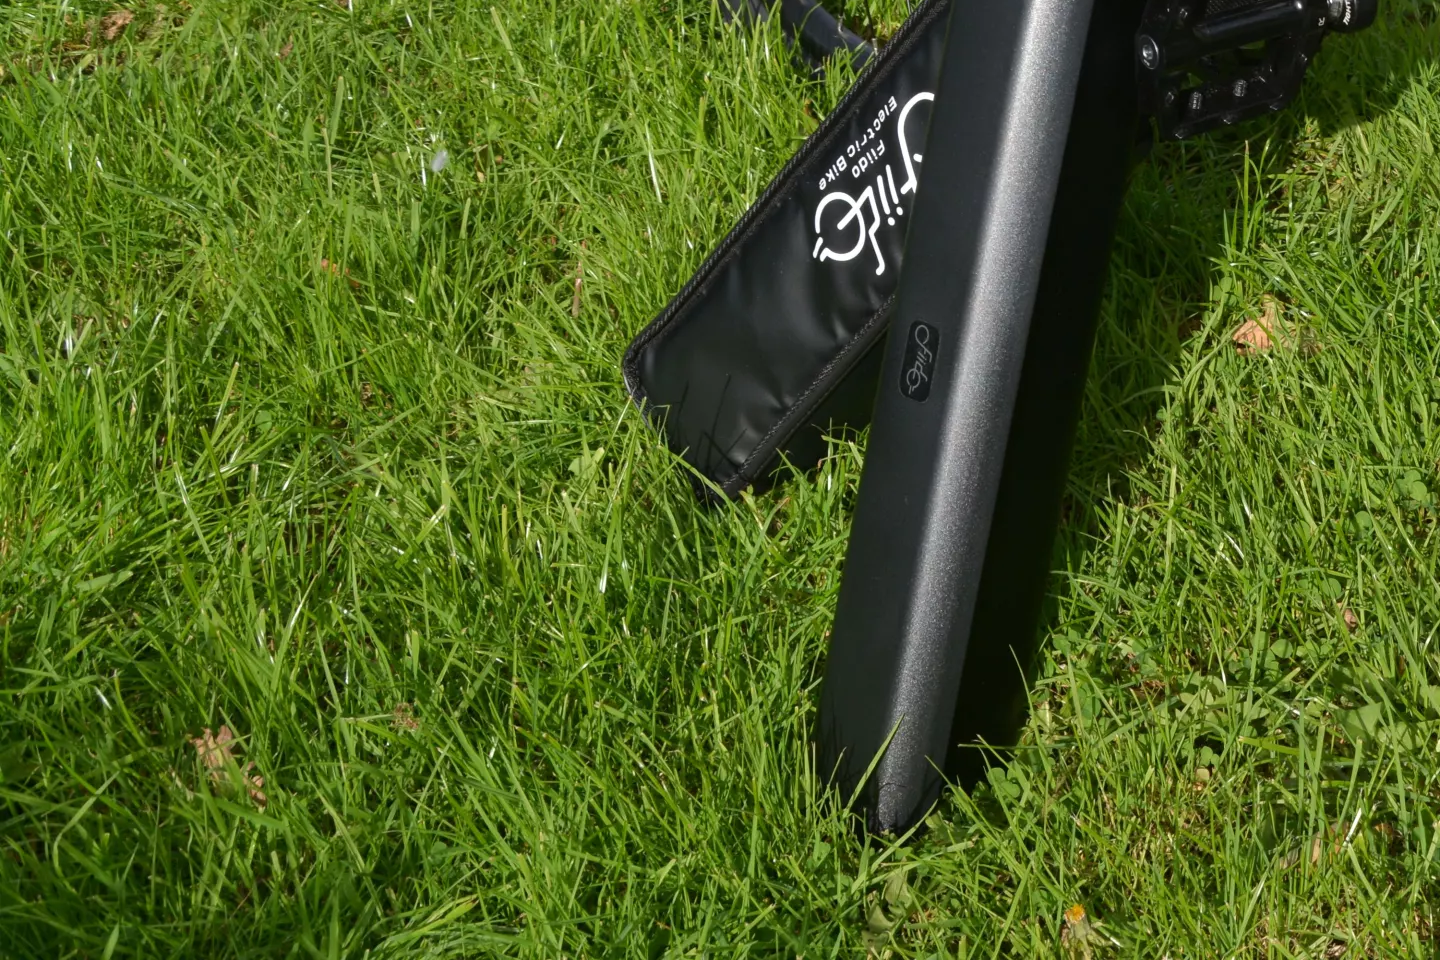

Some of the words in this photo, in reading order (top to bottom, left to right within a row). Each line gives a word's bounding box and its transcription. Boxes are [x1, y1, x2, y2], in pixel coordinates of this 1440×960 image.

[846, 95, 898, 158] Electric
[818, 155, 848, 191] Bike
[851, 139, 886, 179] Fiido
